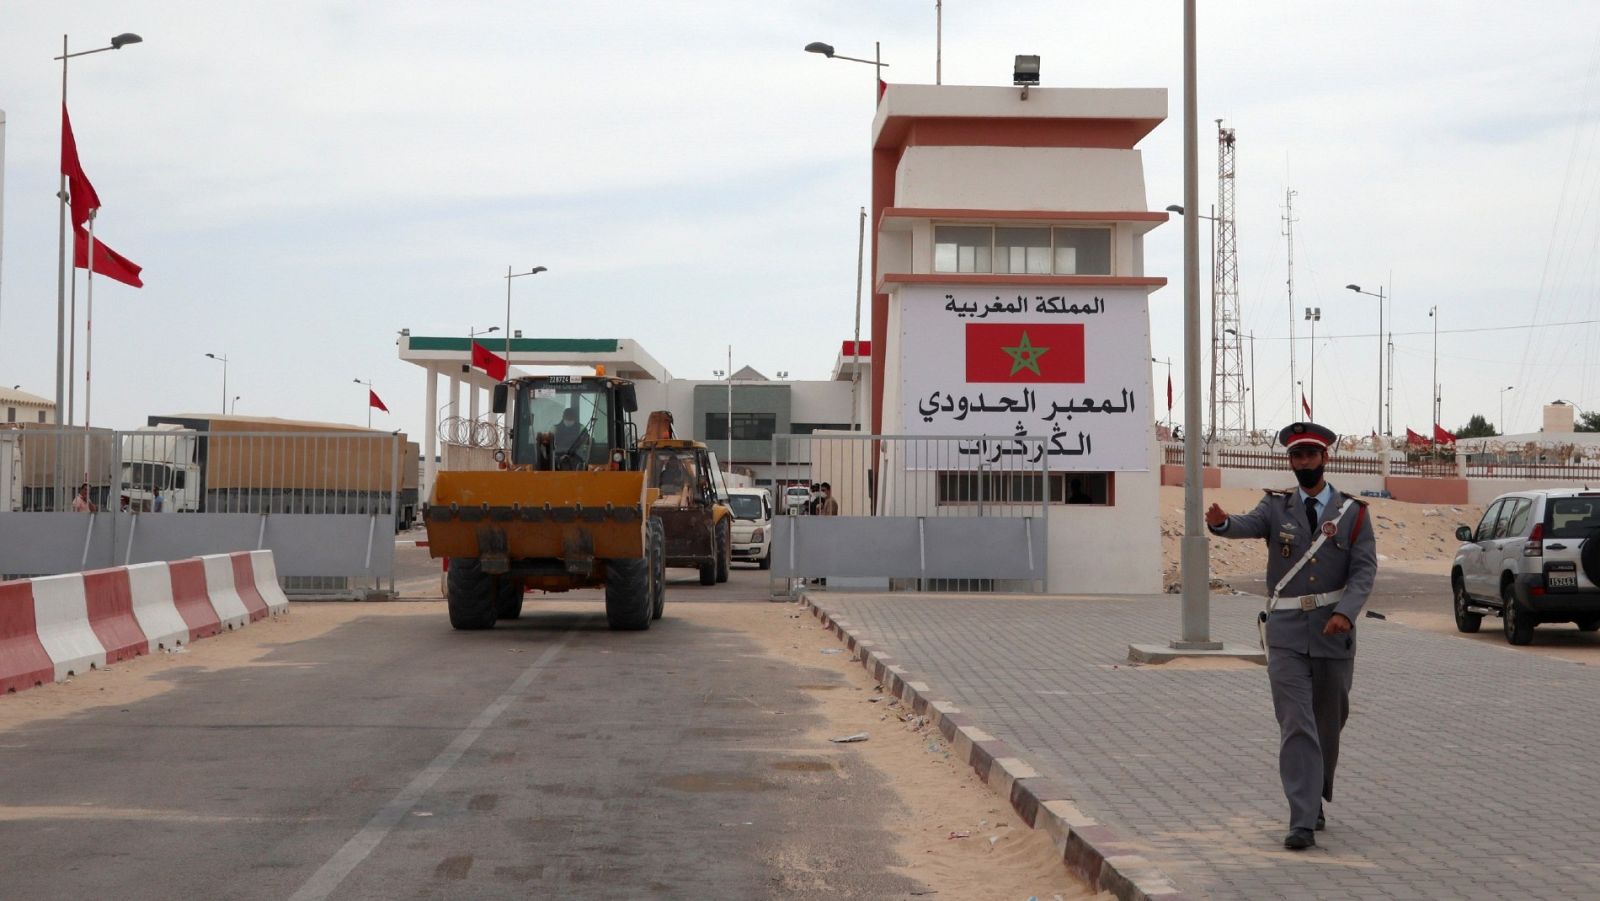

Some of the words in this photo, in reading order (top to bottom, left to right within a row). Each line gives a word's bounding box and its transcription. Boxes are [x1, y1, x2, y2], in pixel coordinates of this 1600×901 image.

[945, 295, 1028, 318] المغربية
[1036, 296, 1105, 314] المملكة
[918, 387, 1036, 422] الحدودي
[1041, 388, 1135, 420] المعبر
